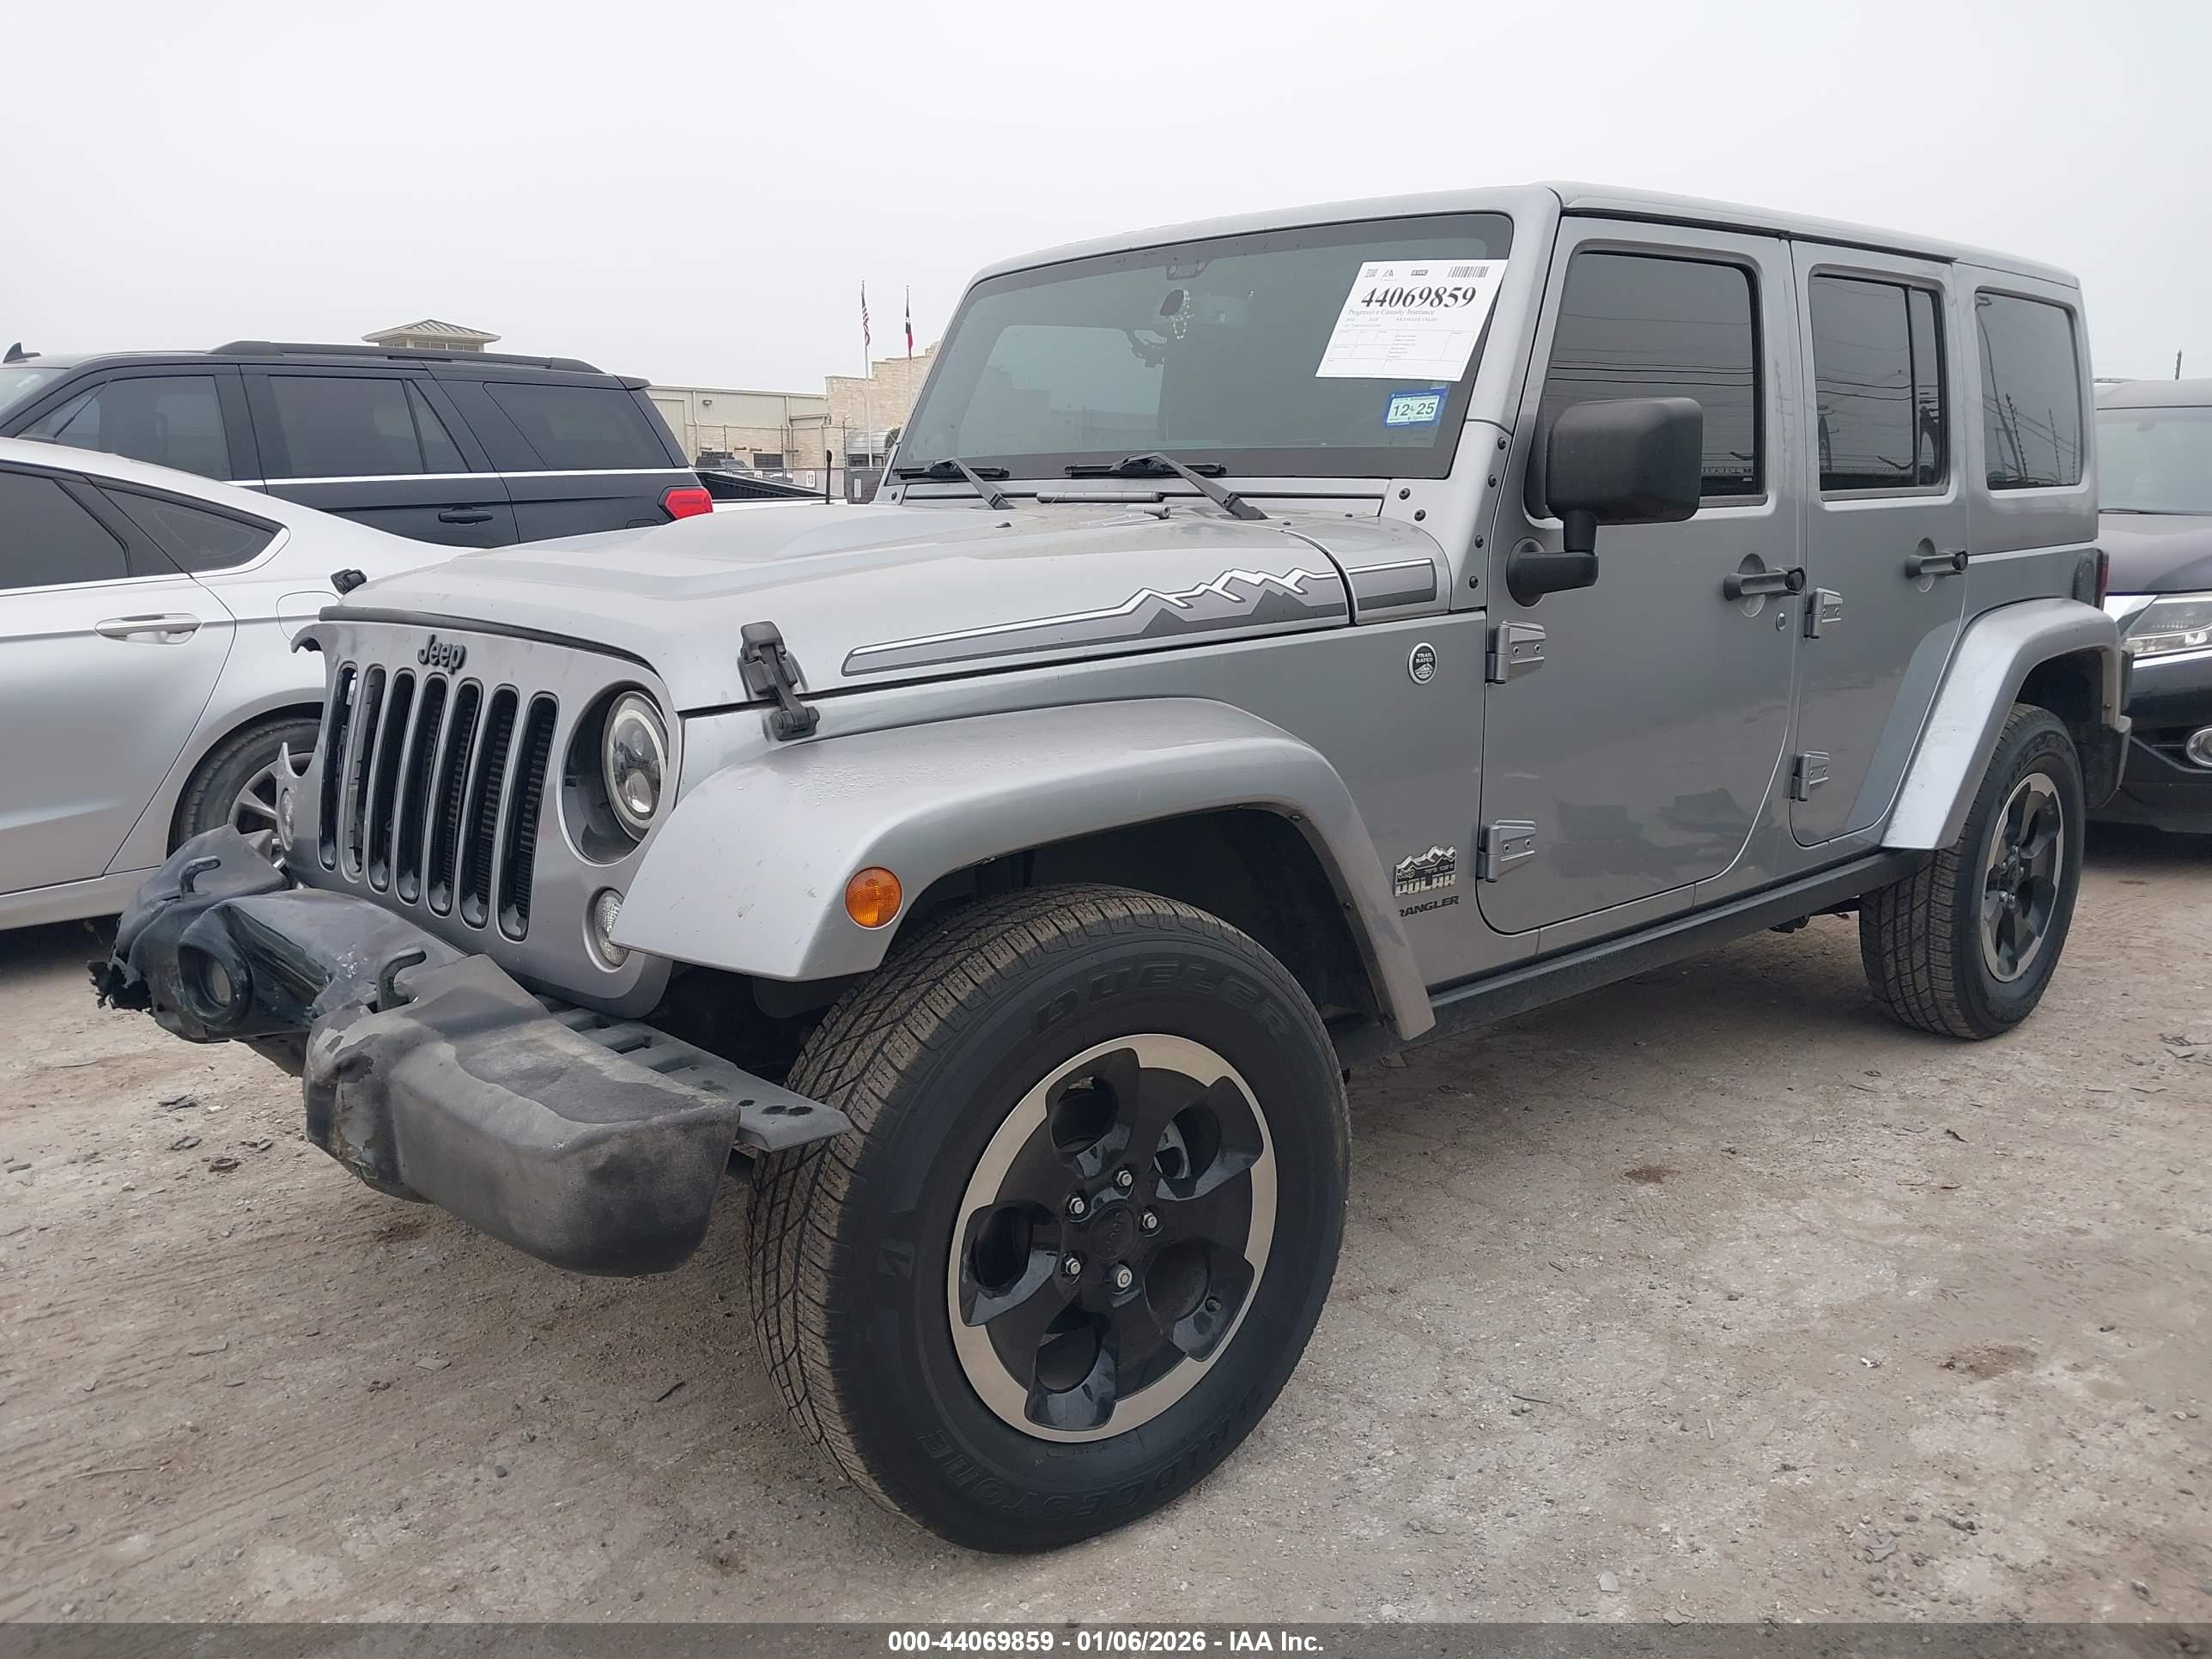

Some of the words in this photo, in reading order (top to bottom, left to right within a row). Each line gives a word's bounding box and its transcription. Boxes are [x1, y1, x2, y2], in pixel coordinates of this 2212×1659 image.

[1361, 286, 1476, 308] 44069859
[417, 635, 468, 674] Jeep
[1395, 872, 1456, 897] POLAR
[1398, 868, 1415, 879] Jeep
[1036, 960, 1288, 1044] DUELER
